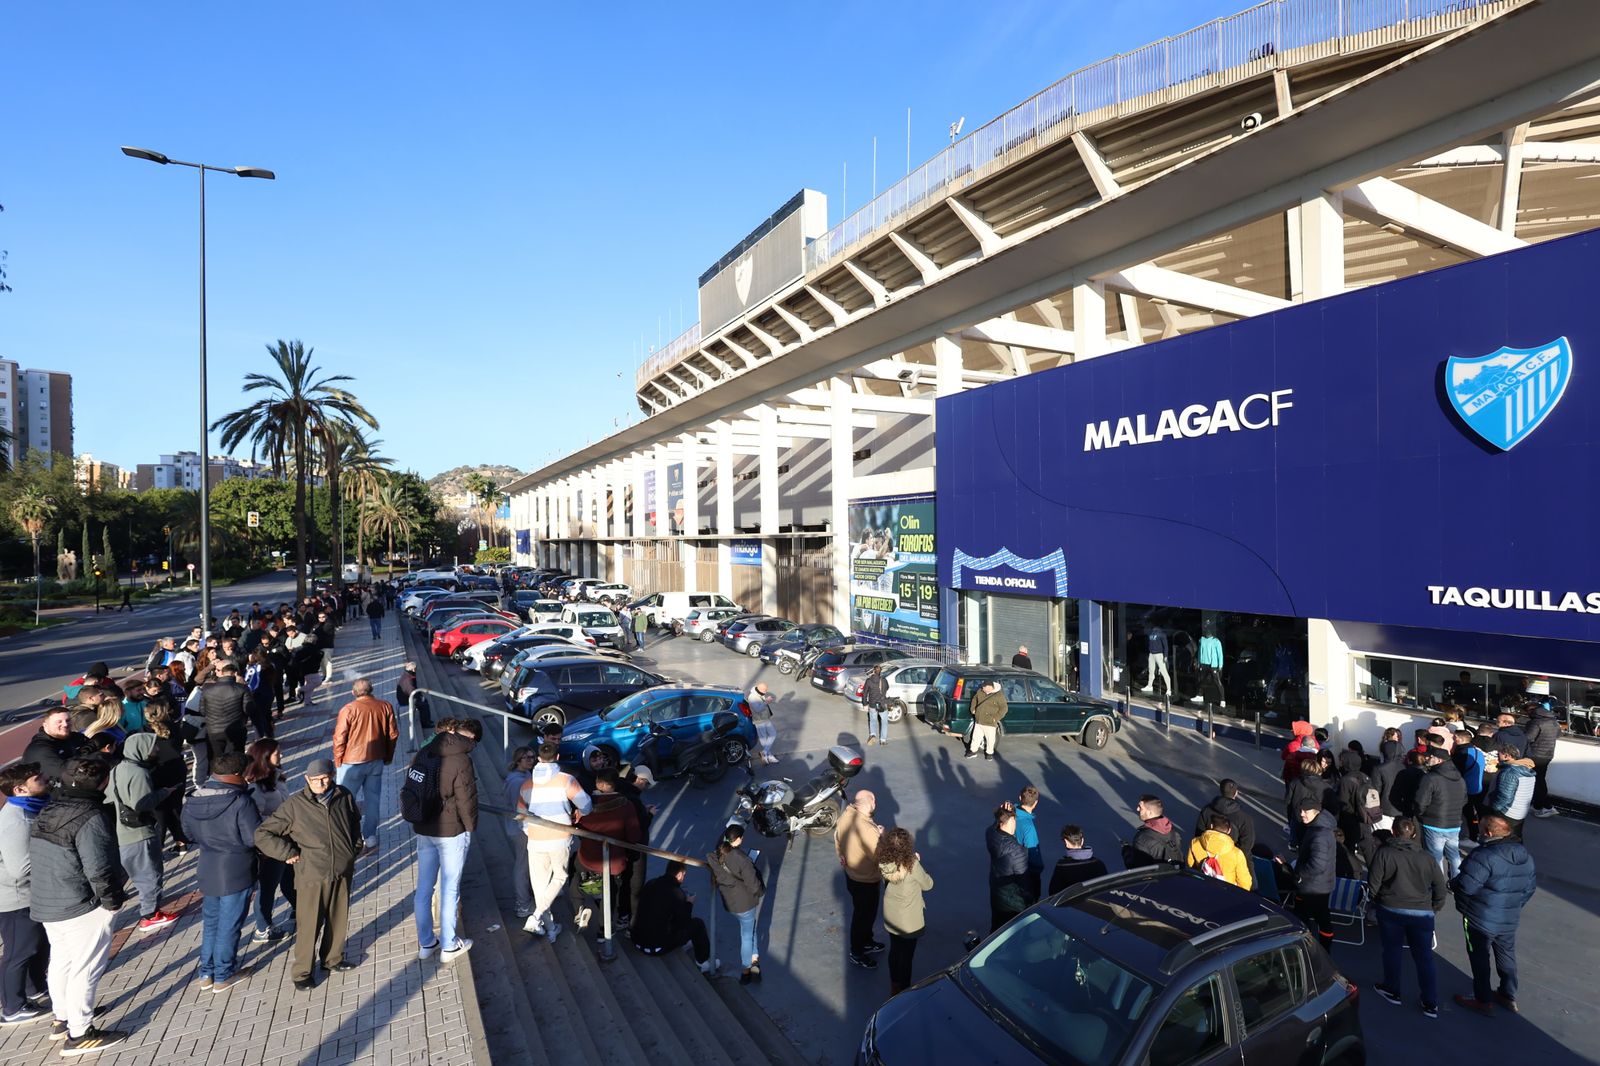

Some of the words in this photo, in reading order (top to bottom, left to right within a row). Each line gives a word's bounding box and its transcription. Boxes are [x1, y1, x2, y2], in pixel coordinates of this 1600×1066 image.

[1083, 388, 1294, 452] MALAGACF
[900, 515, 920, 529] Olin
[899, 534, 934, 552] FOROFOS
[975, 575, 1003, 586] TIENDA
[1004, 577, 1037, 589] OFICIAL
[900, 583, 912, 598] 15
[920, 584, 933, 600] 19
[1428, 585, 1600, 614] TAQUILLAS
